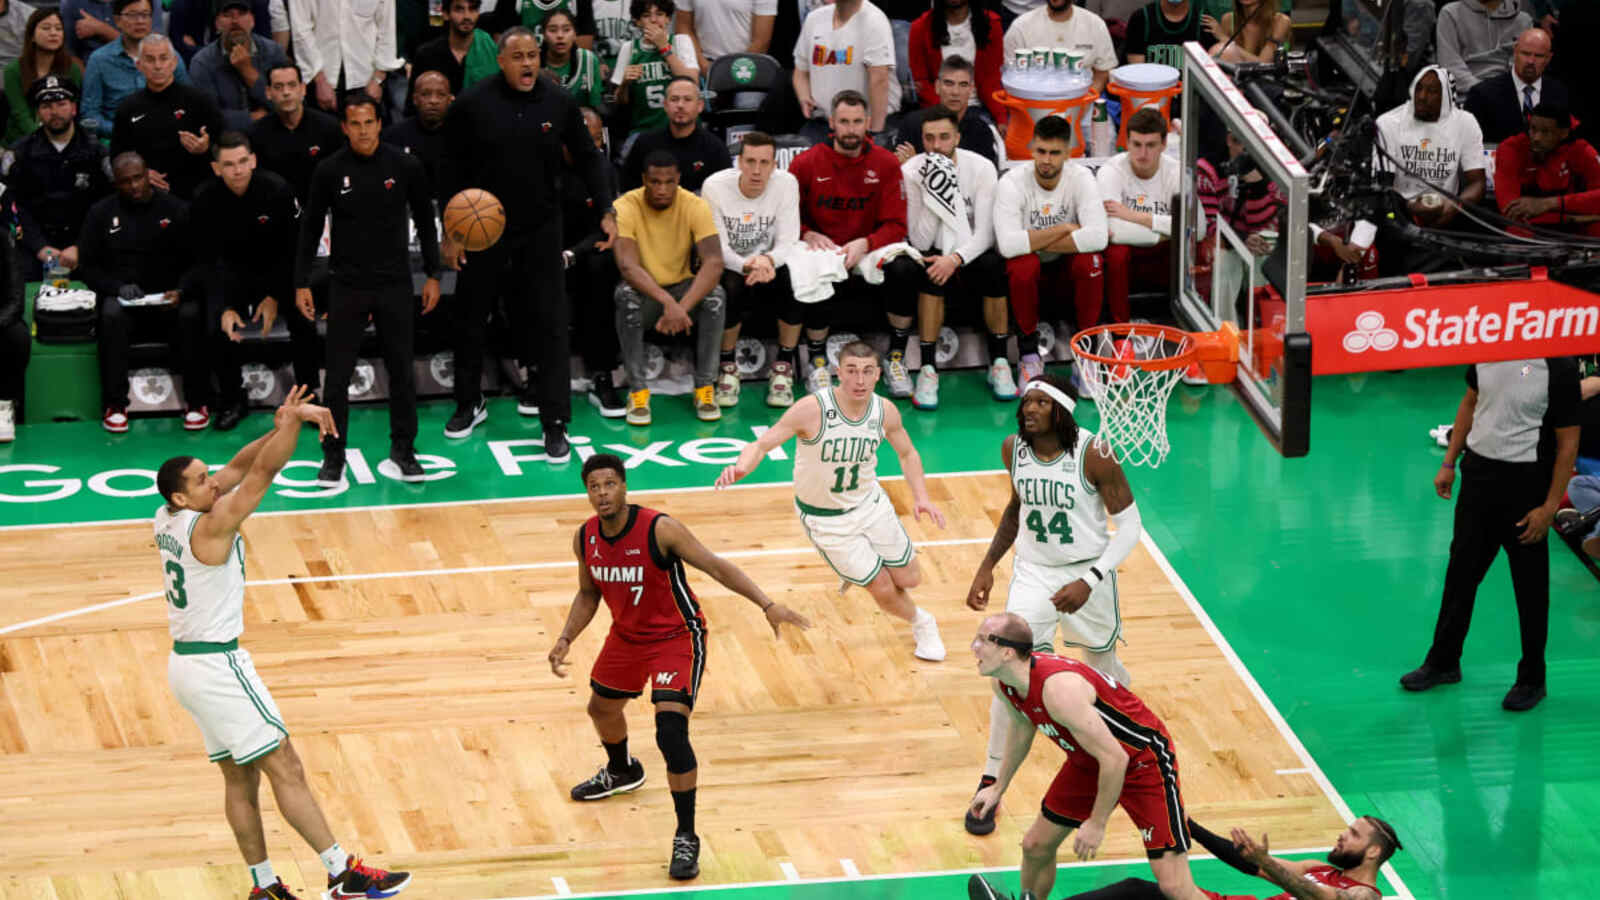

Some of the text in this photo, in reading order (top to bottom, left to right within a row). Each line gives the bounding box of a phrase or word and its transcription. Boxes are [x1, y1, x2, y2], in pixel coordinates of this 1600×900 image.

[1400, 145, 1456, 162] White Hot
[821, 437, 878, 463] CELTICS
[0, 448, 458, 502] Gogle
[830, 464, 860, 493] 11
[1017, 478, 1075, 510] CELTICS
[1026, 509, 1074, 545] 44
[165, 559, 188, 610] 3
[590, 565, 644, 582] MIAMI
[630, 585, 643, 606] 7
